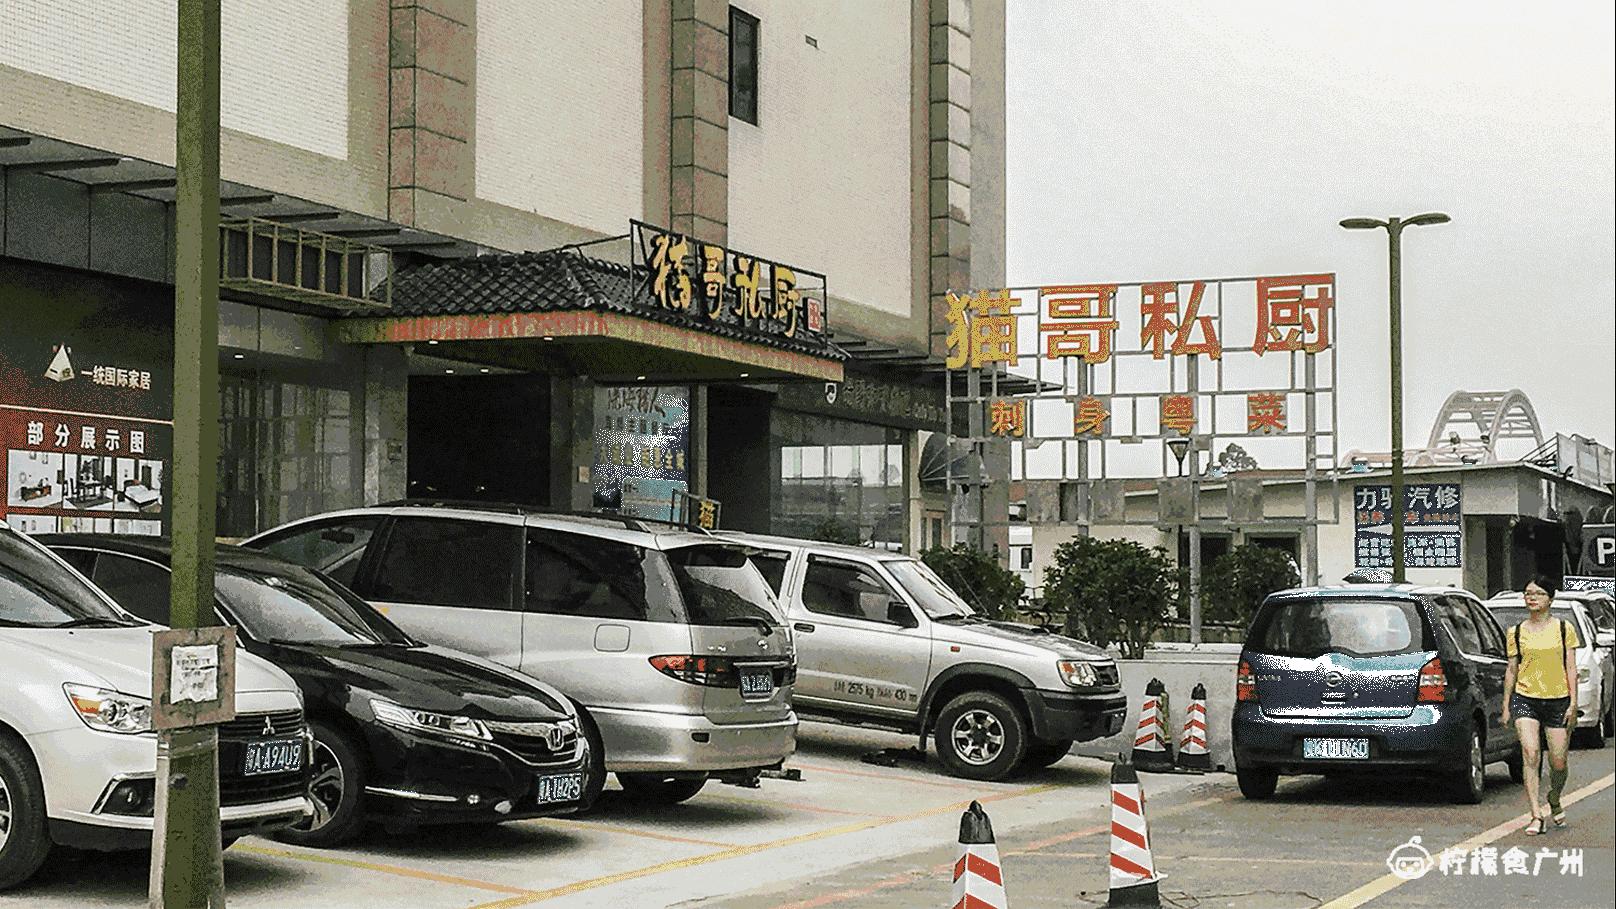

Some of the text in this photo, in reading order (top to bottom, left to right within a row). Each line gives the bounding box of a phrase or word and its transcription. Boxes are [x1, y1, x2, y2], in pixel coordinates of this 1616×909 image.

[946, 274, 1335, 369] 猫哥私厨
[81, 365, 151, 390] 一统国际家居
[990, 393, 1286, 437] 刺身粤菜
[27, 421, 145, 454] 部分展示图
[1597, 538, 1615, 565] P
